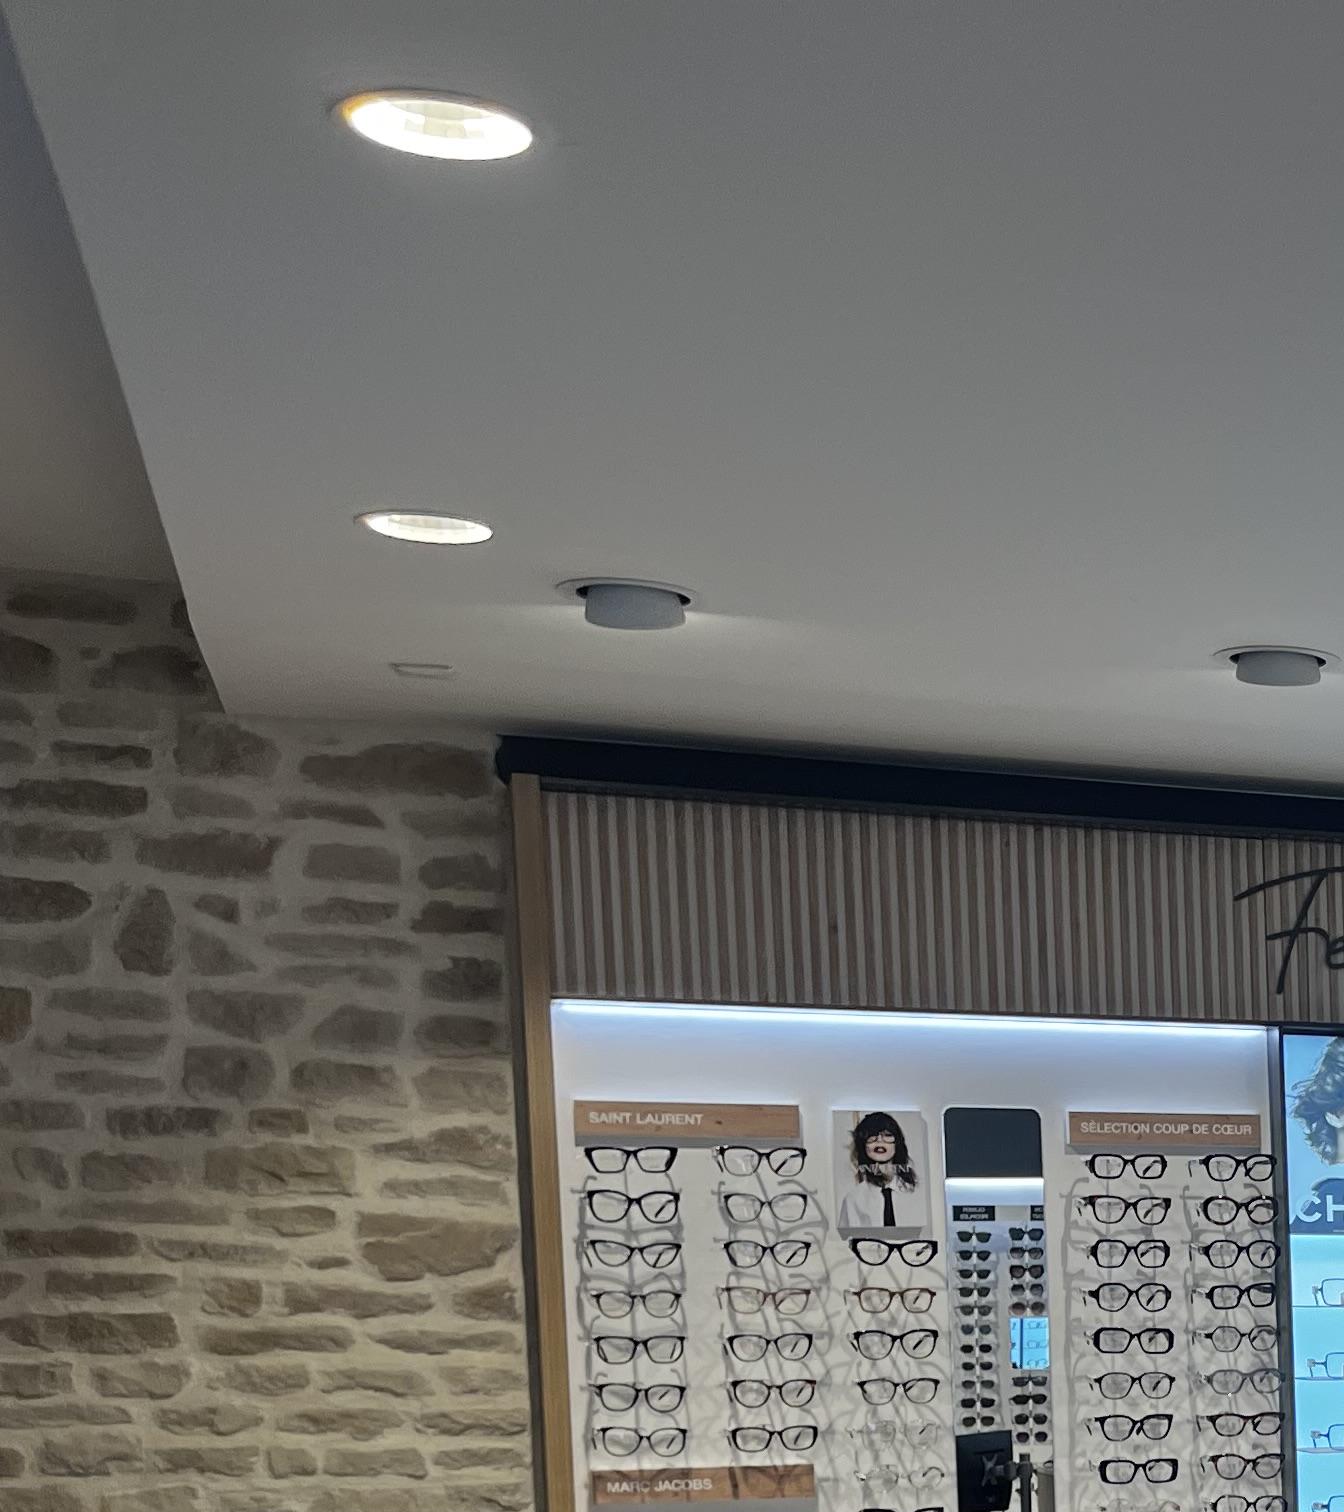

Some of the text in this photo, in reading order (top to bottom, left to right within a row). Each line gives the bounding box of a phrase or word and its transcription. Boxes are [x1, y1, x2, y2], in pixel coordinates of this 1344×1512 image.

[589, 1111, 704, 1126] SAINT LAURENT
[1153, 1123, 1189, 1135] COUP
[1192, 1124, 1209, 1135] DE
[1212, 1124, 1252, 1135] CŒUR
[607, 1478, 713, 1493] MARC JACOBS
